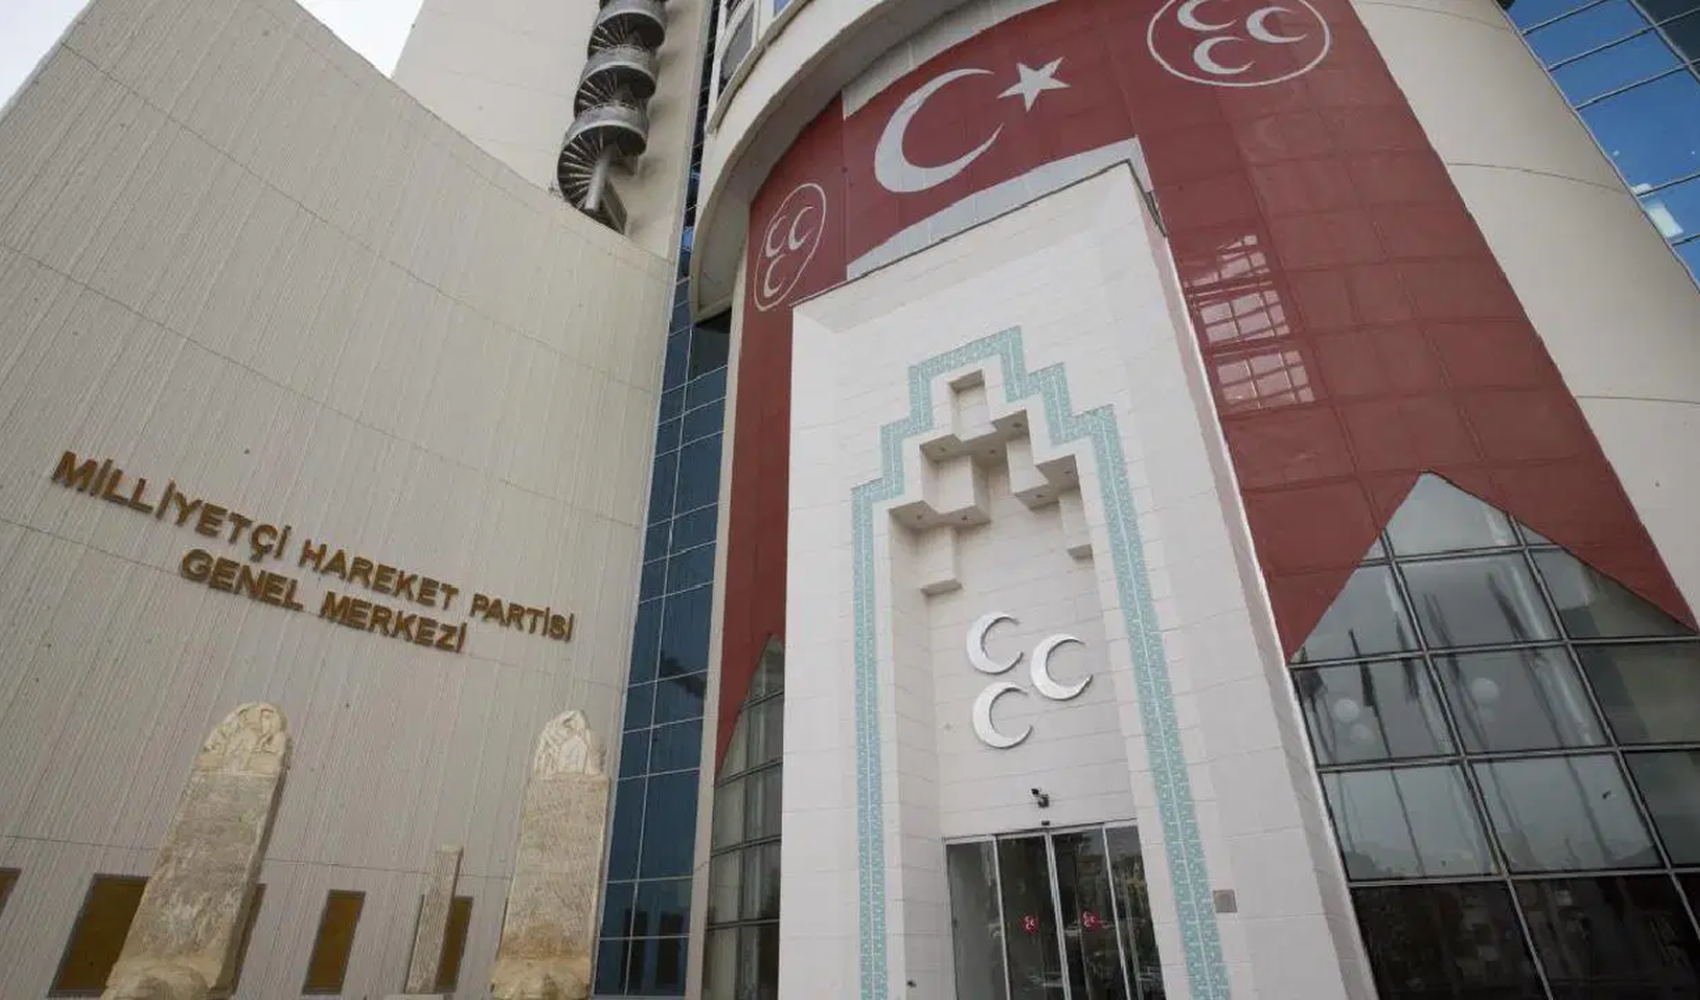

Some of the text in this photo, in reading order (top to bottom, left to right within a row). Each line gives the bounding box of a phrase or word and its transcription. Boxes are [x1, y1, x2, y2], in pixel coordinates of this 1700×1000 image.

[52, 450, 574, 643] MİLLİYETÇİ HAREKET PARTİSİ
[180, 548, 468, 653] GENEL MERKEZİ
